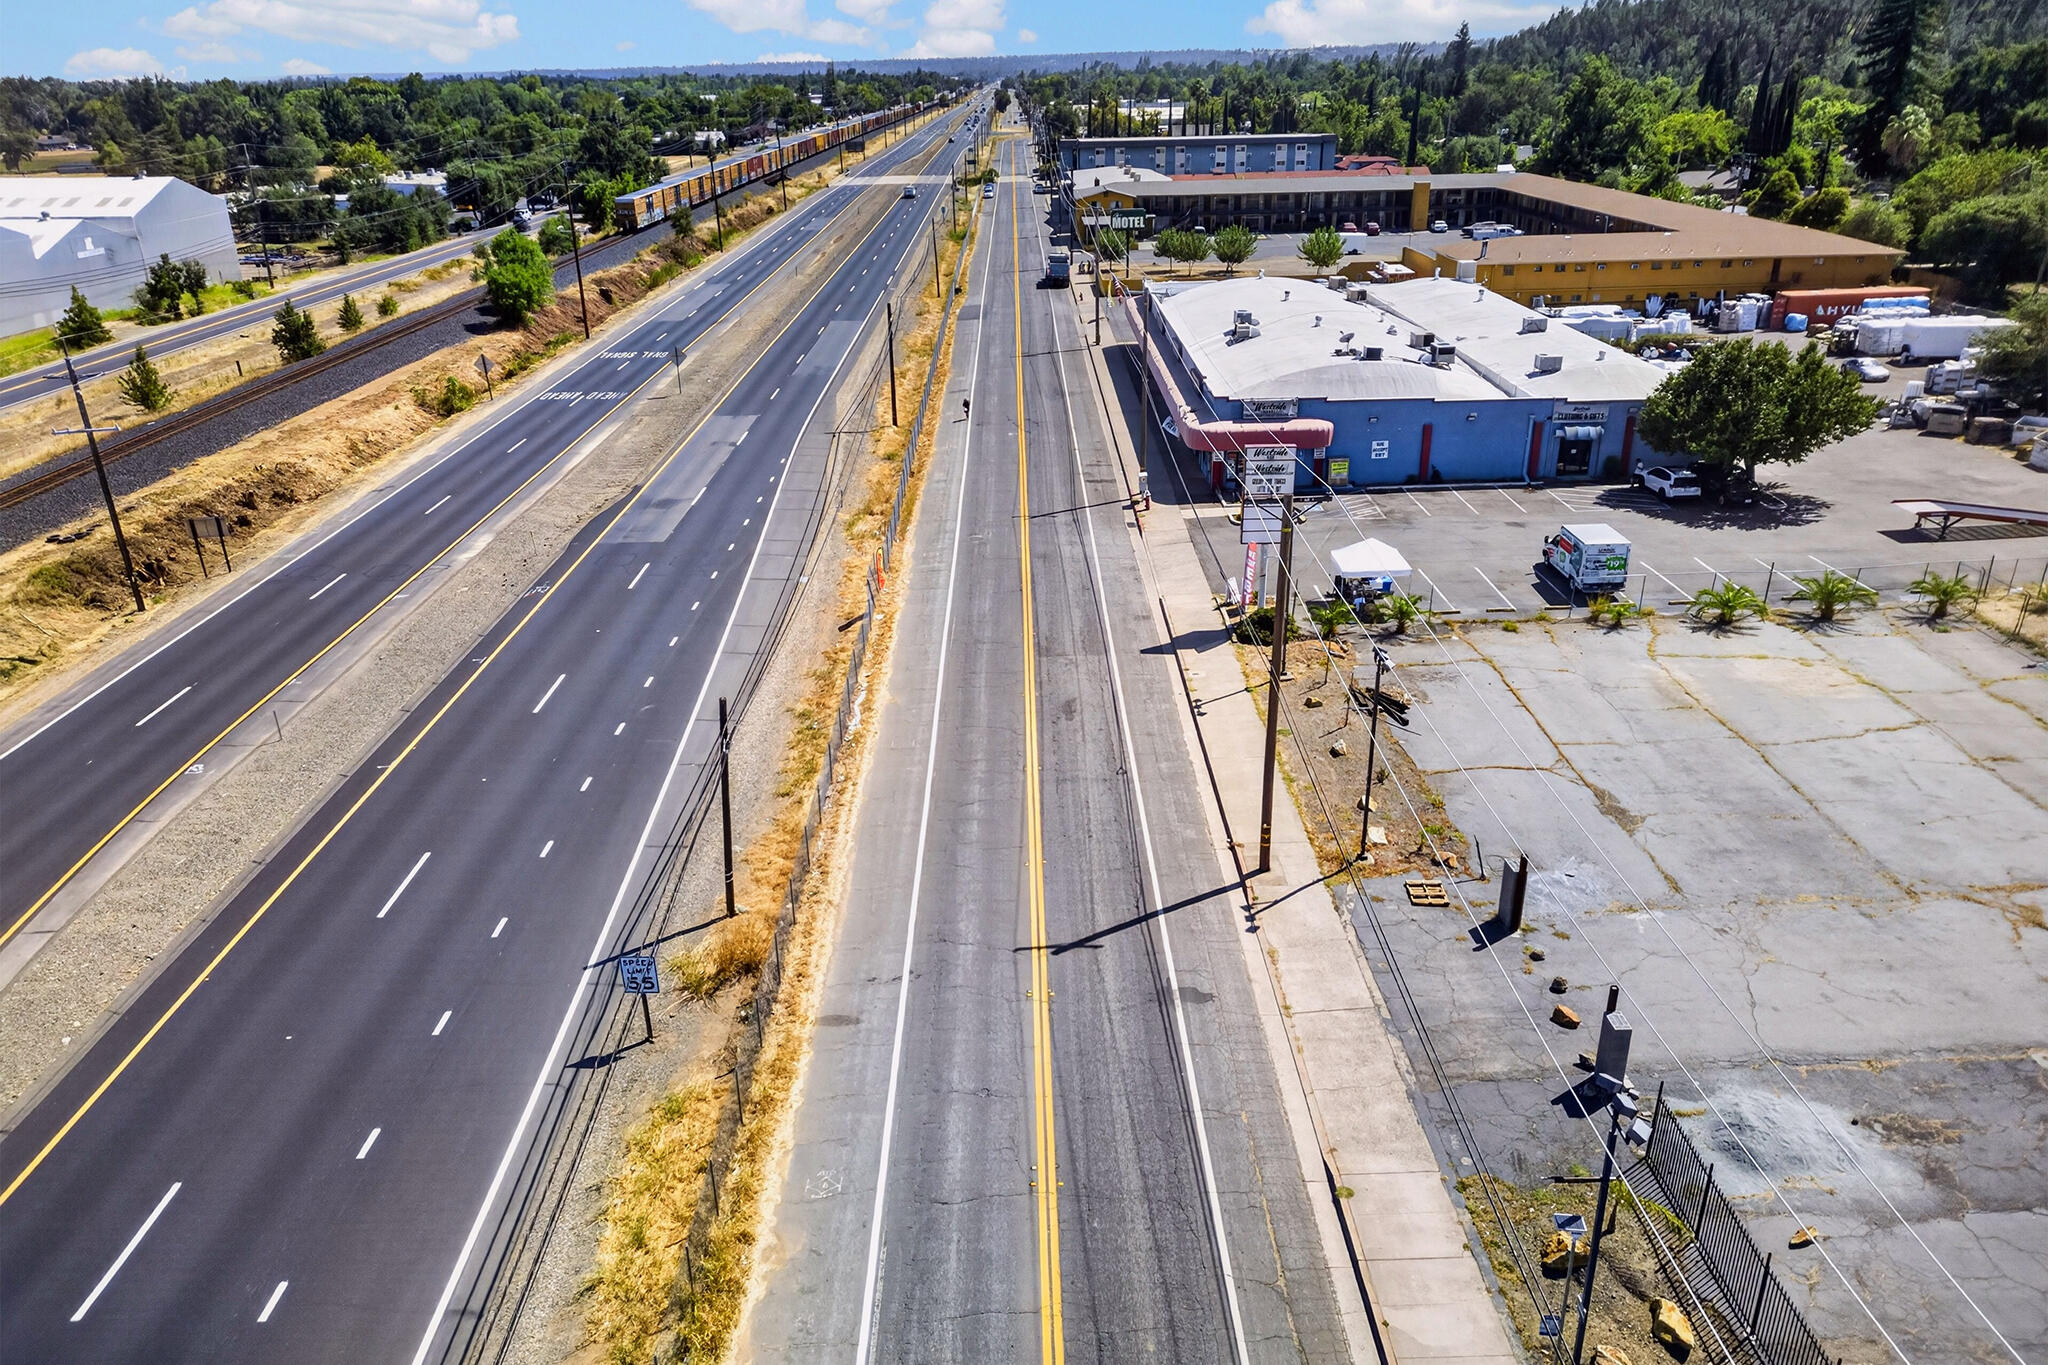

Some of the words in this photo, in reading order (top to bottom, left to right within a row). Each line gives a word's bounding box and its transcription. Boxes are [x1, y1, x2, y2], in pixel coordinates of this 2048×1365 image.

[1112, 216, 1145, 229] MOTEL
[540, 391, 583, 400] AHEAD
[1253, 449, 1288, 457] Westside
[622, 959, 654, 967] SPEED
[627, 967, 652, 975] LIMIT
[628, 976, 655, 990] 55
